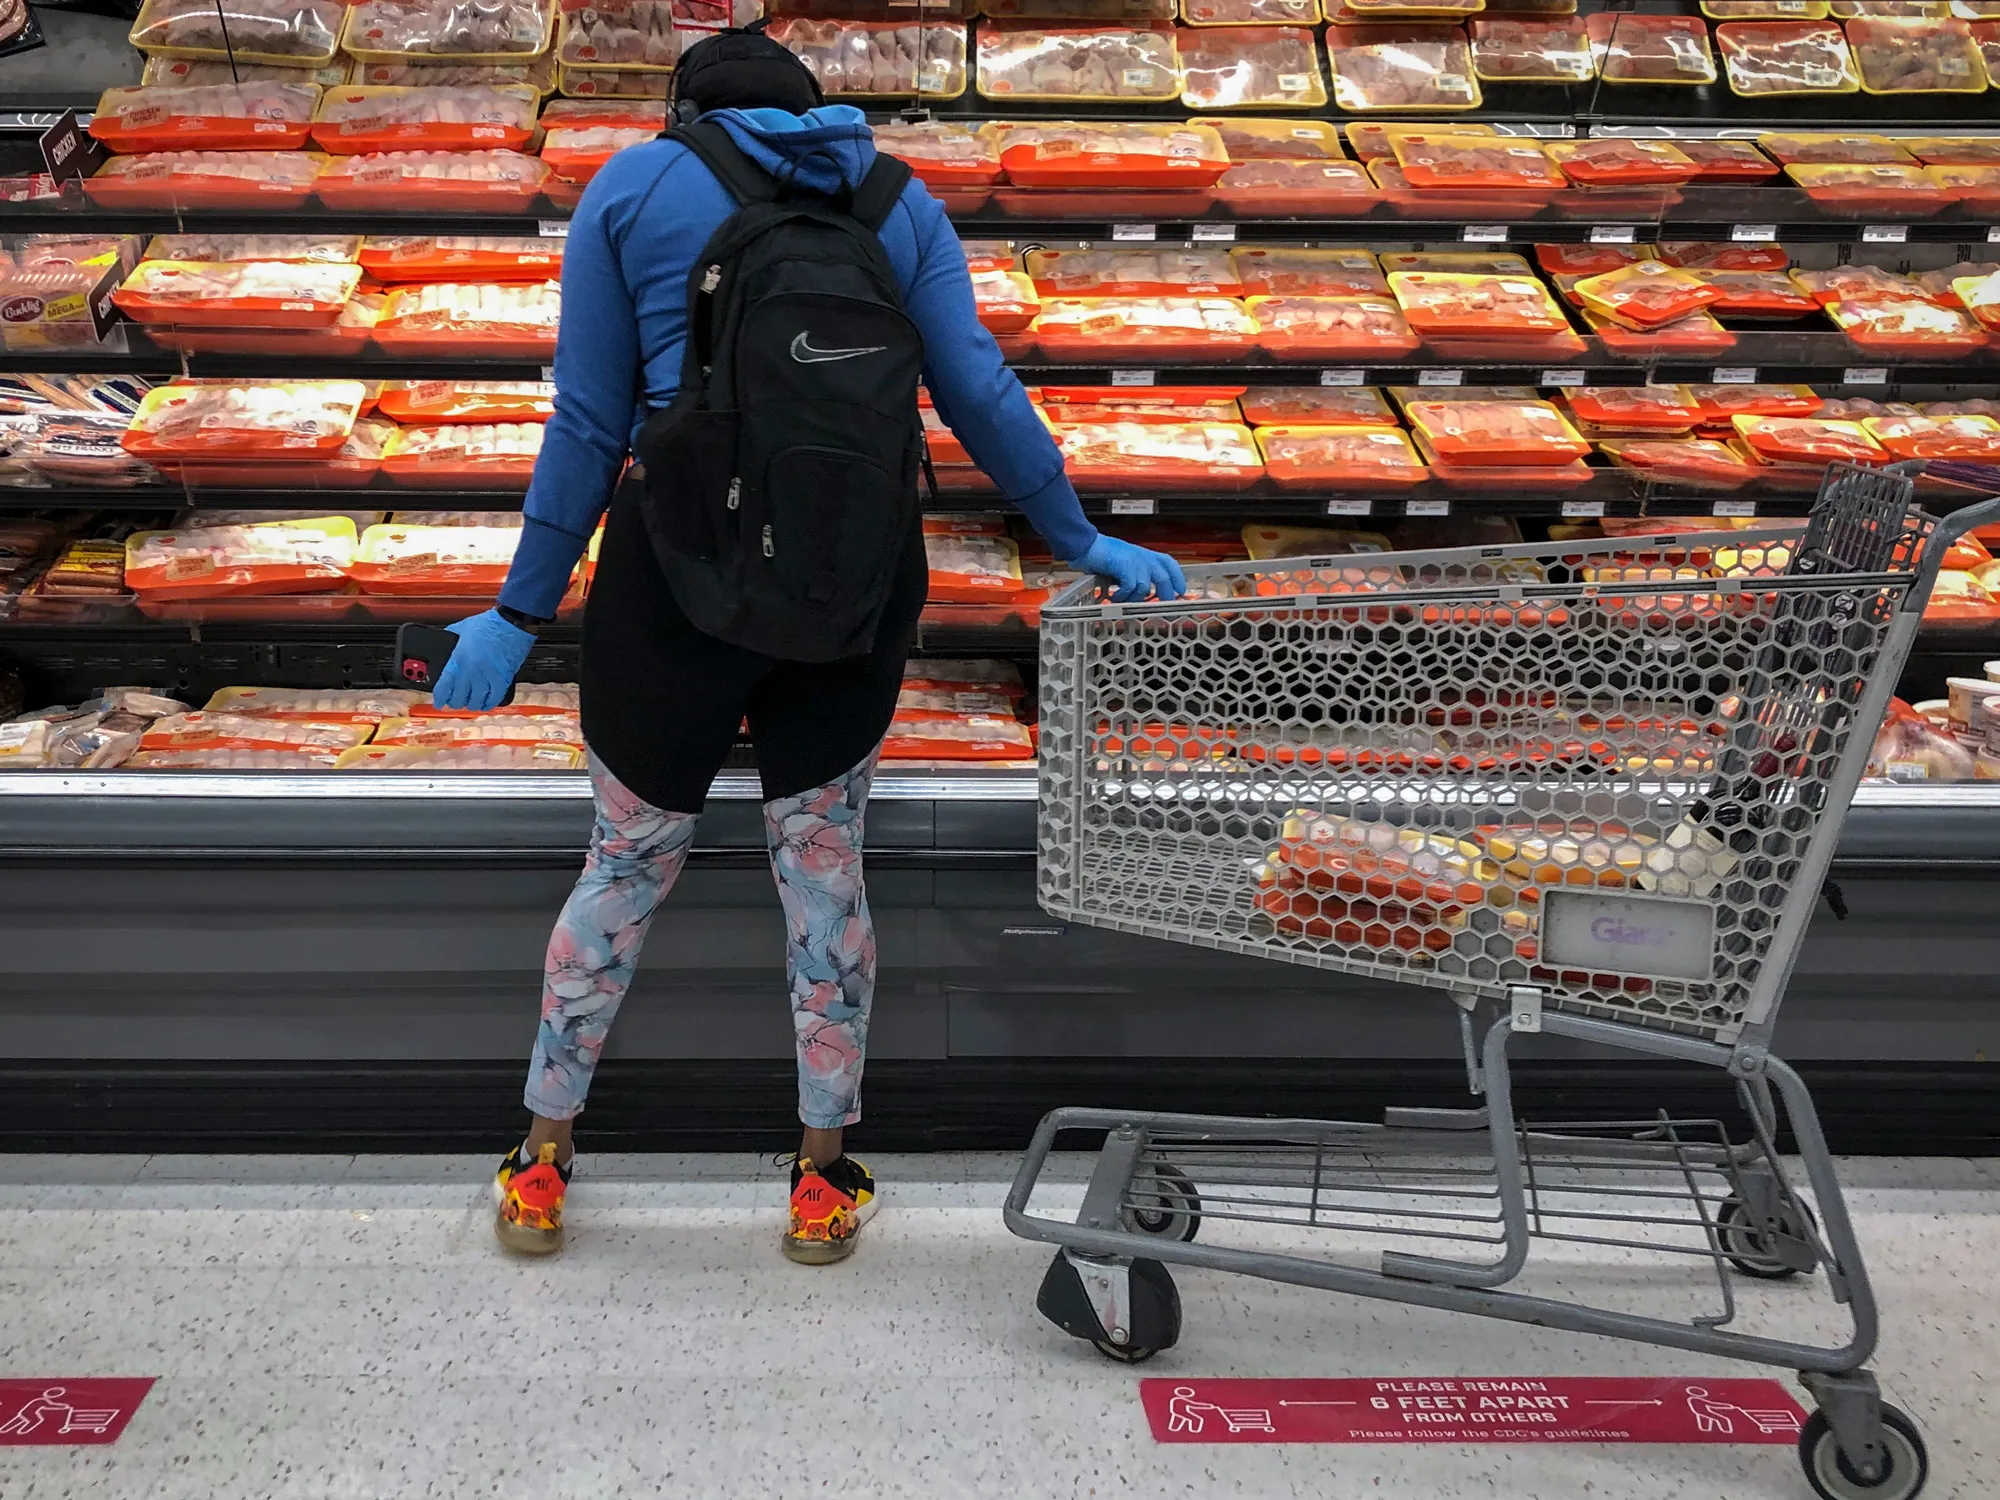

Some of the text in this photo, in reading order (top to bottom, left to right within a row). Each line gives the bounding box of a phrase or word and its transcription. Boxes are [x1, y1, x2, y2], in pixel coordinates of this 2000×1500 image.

[52, 129, 78, 166] CHICKEN
[5, 299, 40, 319] Buddig
[47, 302, 75, 318] MEGA
[1376, 1382, 1547, 1392] PLEASE REMAIN
[1370, 1396, 1569, 1409] 6 FEET APART
[1402, 1412, 1557, 1423] FROM OTHERS
[1349, 1429, 1630, 1439] Please follow the CDC's guidelines
